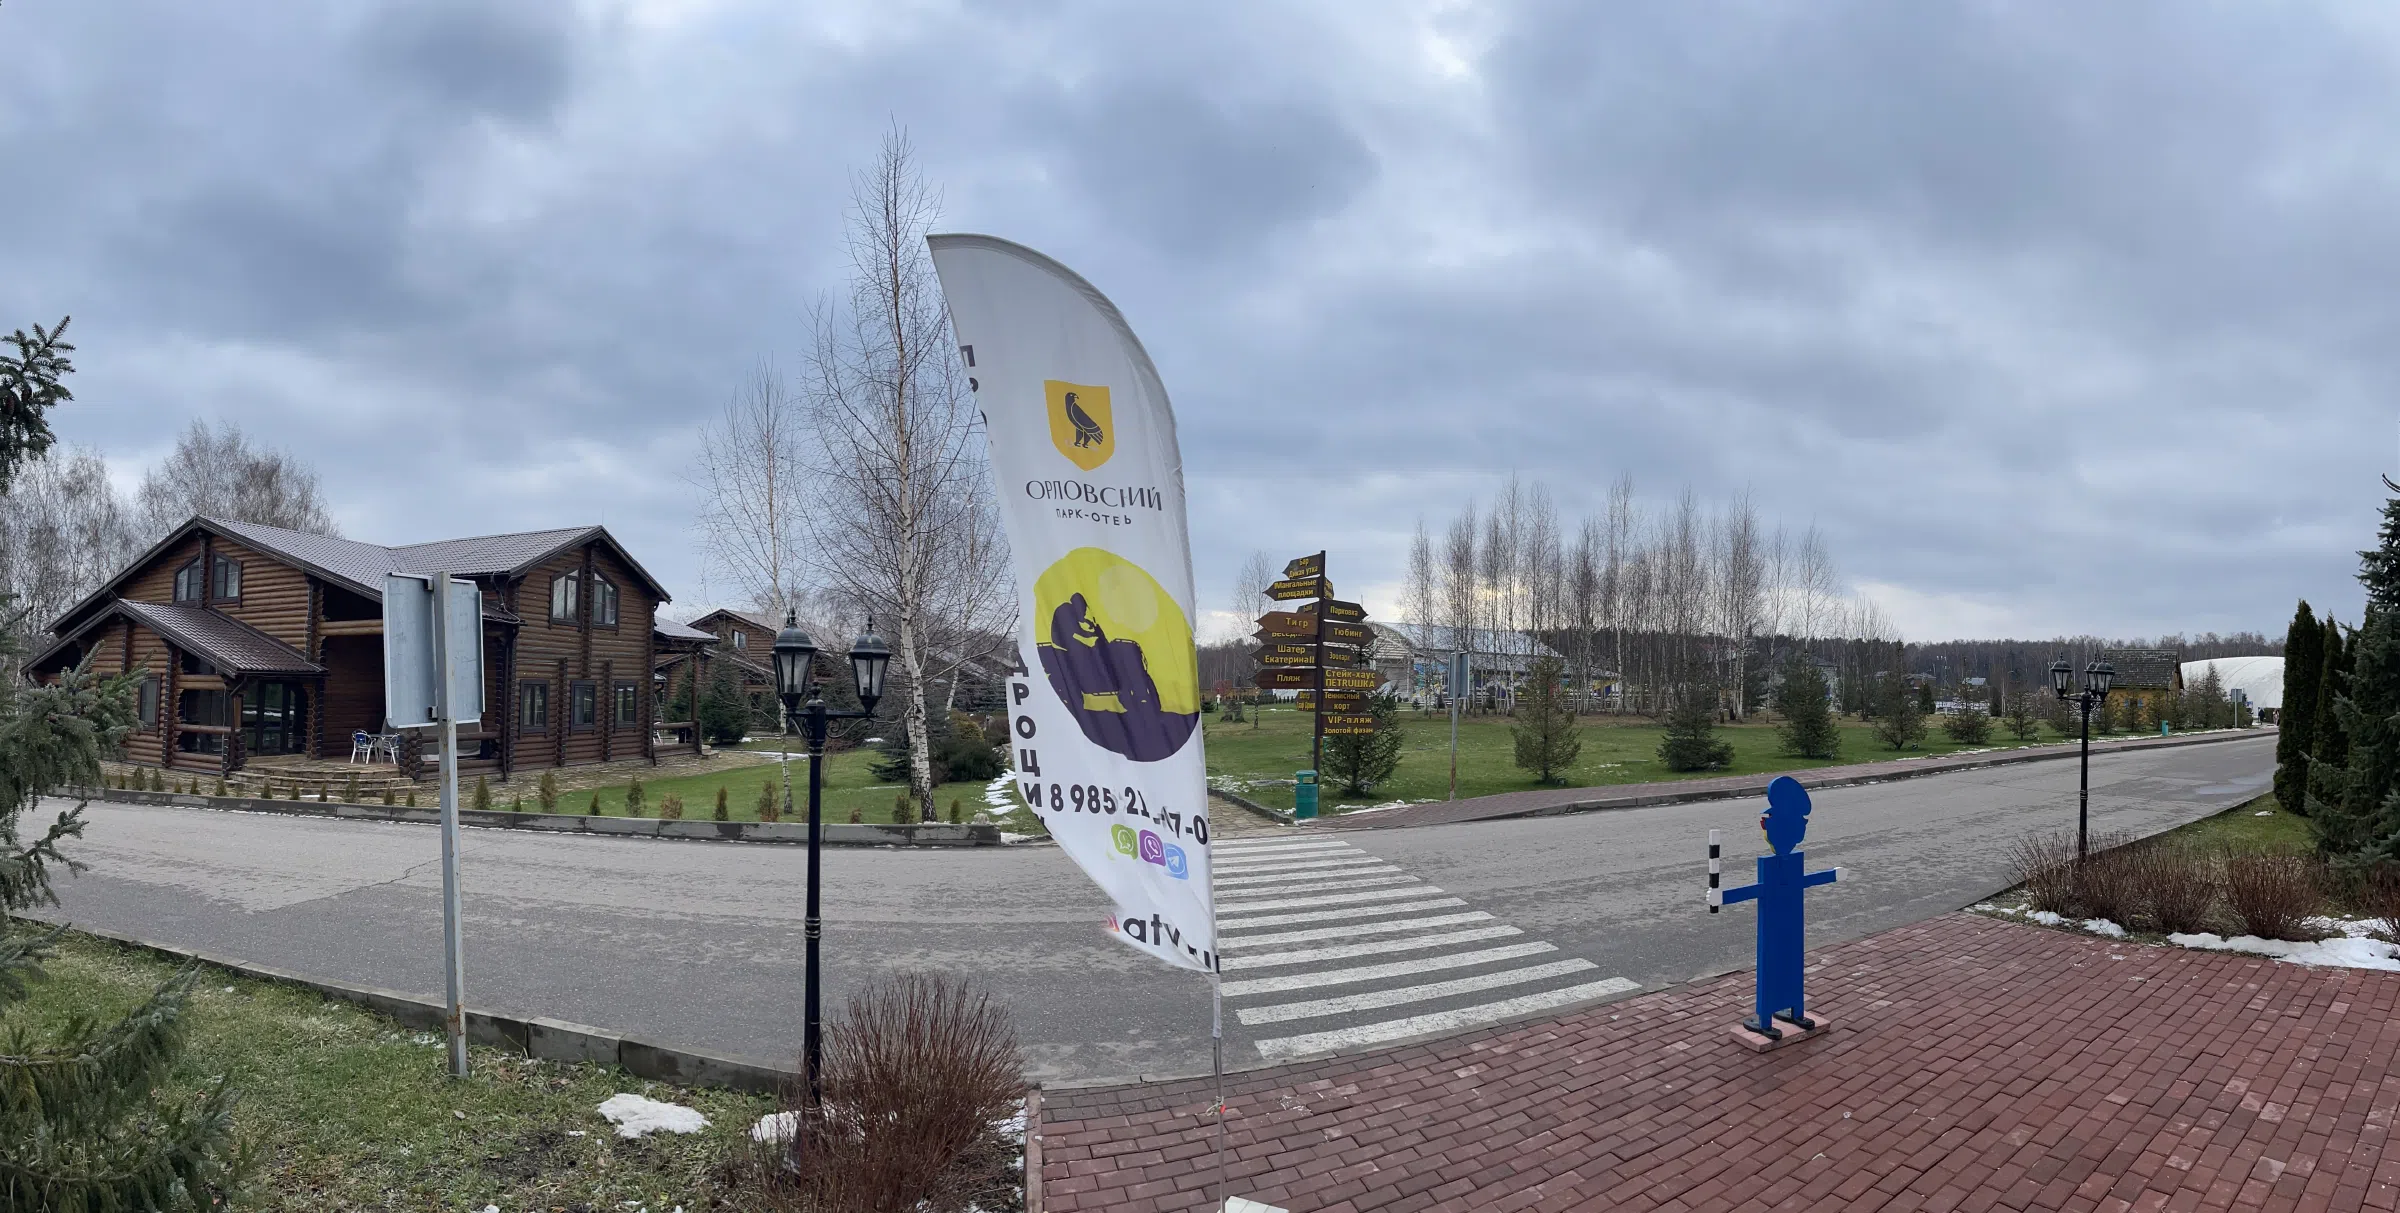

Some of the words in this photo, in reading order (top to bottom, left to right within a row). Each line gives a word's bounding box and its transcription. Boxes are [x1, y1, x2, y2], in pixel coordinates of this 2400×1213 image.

[1274, 580, 1317, 589] Мангальные
[1277, 590, 1314, 599] площадки
[1330, 605, 1359, 617] Парковка
[1285, 617, 1309, 629] Тигр
[1333, 627, 1363, 638] Тюбинг
[1277, 644, 1306, 654] Шатер
[1276, 674, 1301, 682] Пляж
[1325, 669, 1376, 679] Стейк-хаус
[1324, 691, 1360, 700] Теннисный
[1333, 703, 1351, 712] корт
[1327, 715, 1373, 724] VIP-пляж
[1323, 726, 1351, 734] Золотой
[1353, 726, 1374, 736] фазан
[1050, 783, 1064, 812] 8
[1069, 784, 1118, 815] 985
